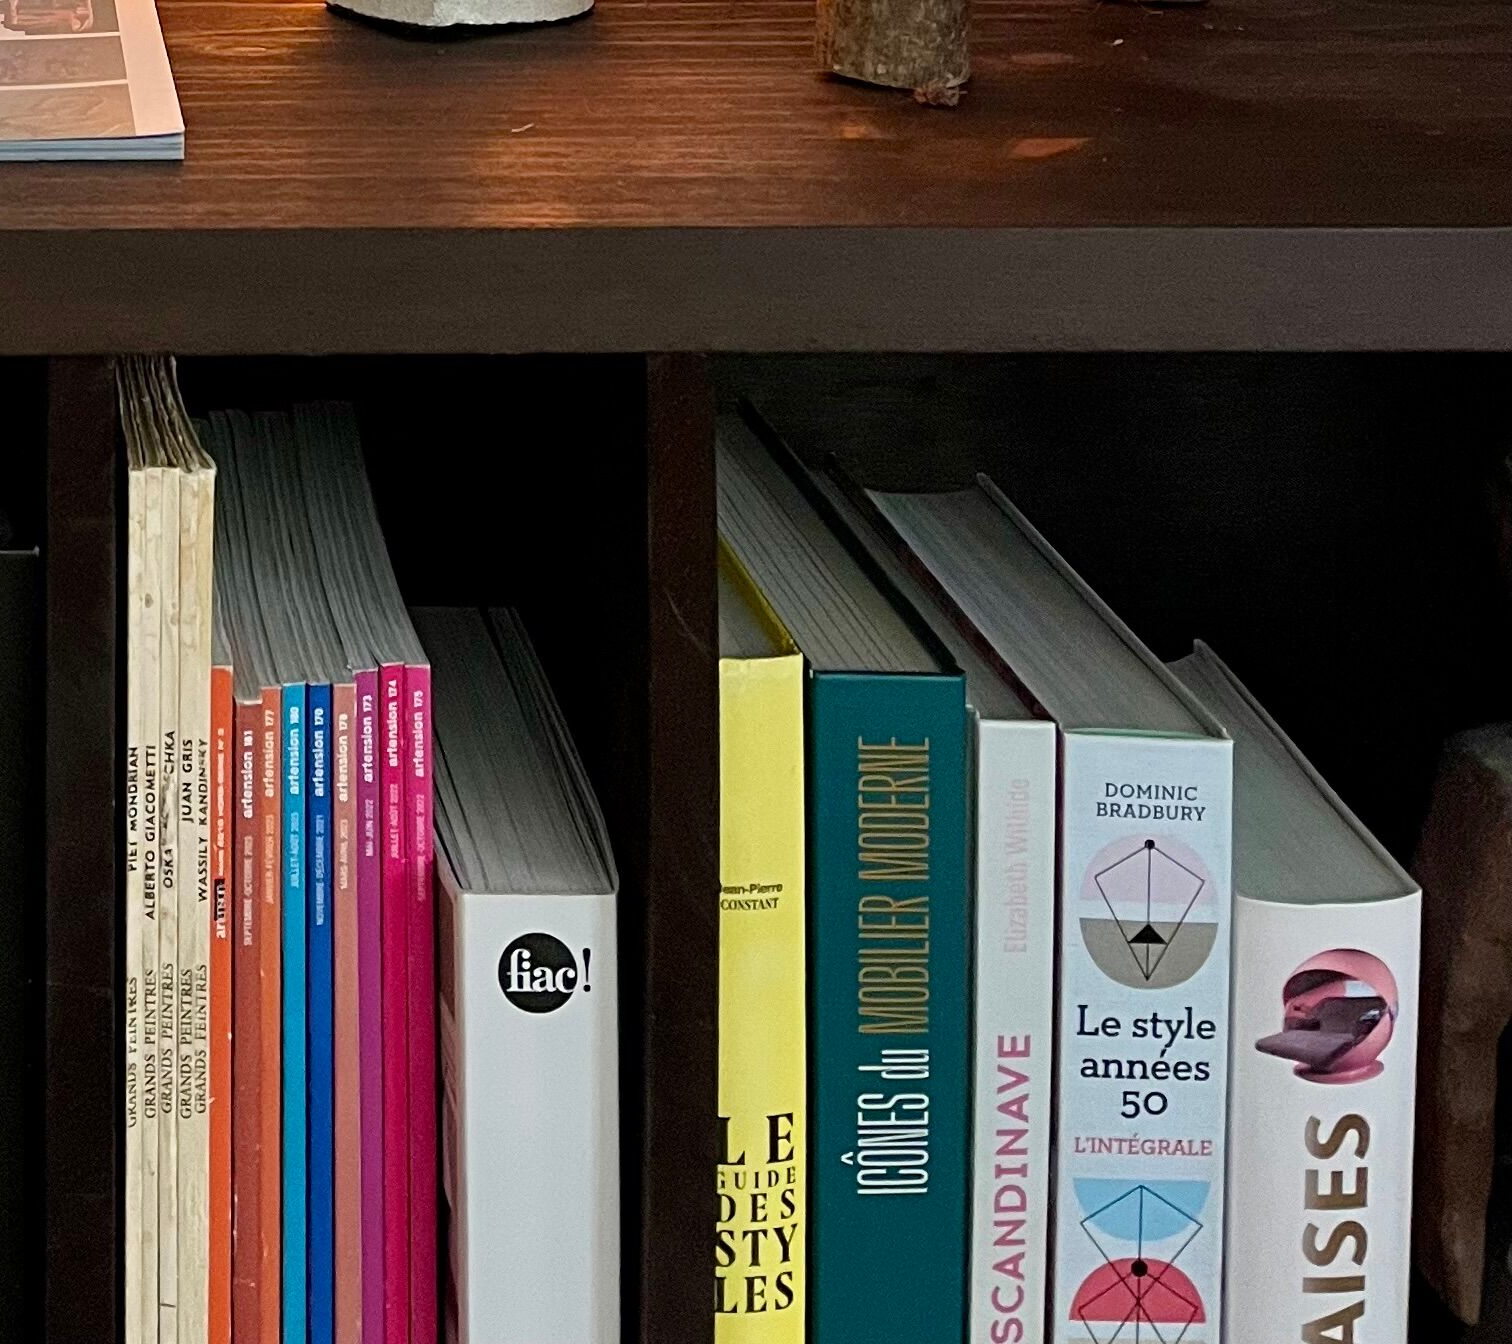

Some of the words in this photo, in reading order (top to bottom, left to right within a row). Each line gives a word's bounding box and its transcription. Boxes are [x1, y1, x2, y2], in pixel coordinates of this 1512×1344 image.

[265, 710, 274, 726] 177
[314, 707, 324, 726] 170
[363, 695, 373, 712] 173
[388, 680, 398, 697] 174
[413, 690, 423, 708] 175
[181, 739, 194, 773] GRIS
[244, 730, 253, 747] 181
[263, 731, 274, 797] artension
[288, 728, 299, 795] artension
[312, 730, 325, 797] artension
[362, 717, 374, 782] artension
[387, 702, 399, 767] artension
[412, 712, 424, 777] artension
[128, 746, 138, 831] MONDRIAN
[144, 745, 156, 842] GIACOMETTI
[241, 752, 254, 818] artension
[337, 735, 349, 802] artension
[1105, 782, 1198, 802] DOMINIC
[181, 782, 194, 823] JUAN
[857, 736, 930, 881] MODERNE
[1003, 778, 1030, 855] Wilhide
[1096, 802, 1207, 821] BRADBURY
[144, 850, 156, 920] ALBERTO
[198, 837, 209, 902] WASSILY
[720, 897, 779, 911] CONSTANT
[1001, 860, 1028, 954] Elizabeth
[506, 947, 591, 993] fiac!
[857, 895, 930, 1034] MOBILIER
[143, 969, 157, 1045] PEINTRES
[161, 962, 174, 1040] PEINTRES
[180, 969, 193, 1045] PEINTRES
[195, 964, 208, 1042] PEINTRES
[1076, 1004, 1122, 1040] Le
[1131, 1007, 1217, 1048] style
[143, 1050, 157, 1119] GRANDS
[160, 1048, 173, 1114] GRANDS
[180, 1054, 193, 1119] GRANDS
[195, 1050, 208, 1114] GRANDS
[859, 1049, 930, 1079] du
[1079, 1048, 1211, 1084] années
[1121, 1091, 1168, 1117] 50
[719, 1112, 794, 1165] LE
[840, 1092, 930, 1195] ICÔNES
[1074, 1134, 1213, 1158] L'INTÉGRALE
[716, 1188, 795, 1223] DES
[991, 1034, 1032, 1344] SCANDINAVE
[715, 1223, 798, 1268] STY
[1300, 1113, 1371, 1344] AISES
[715, 1271, 795, 1314] LES
